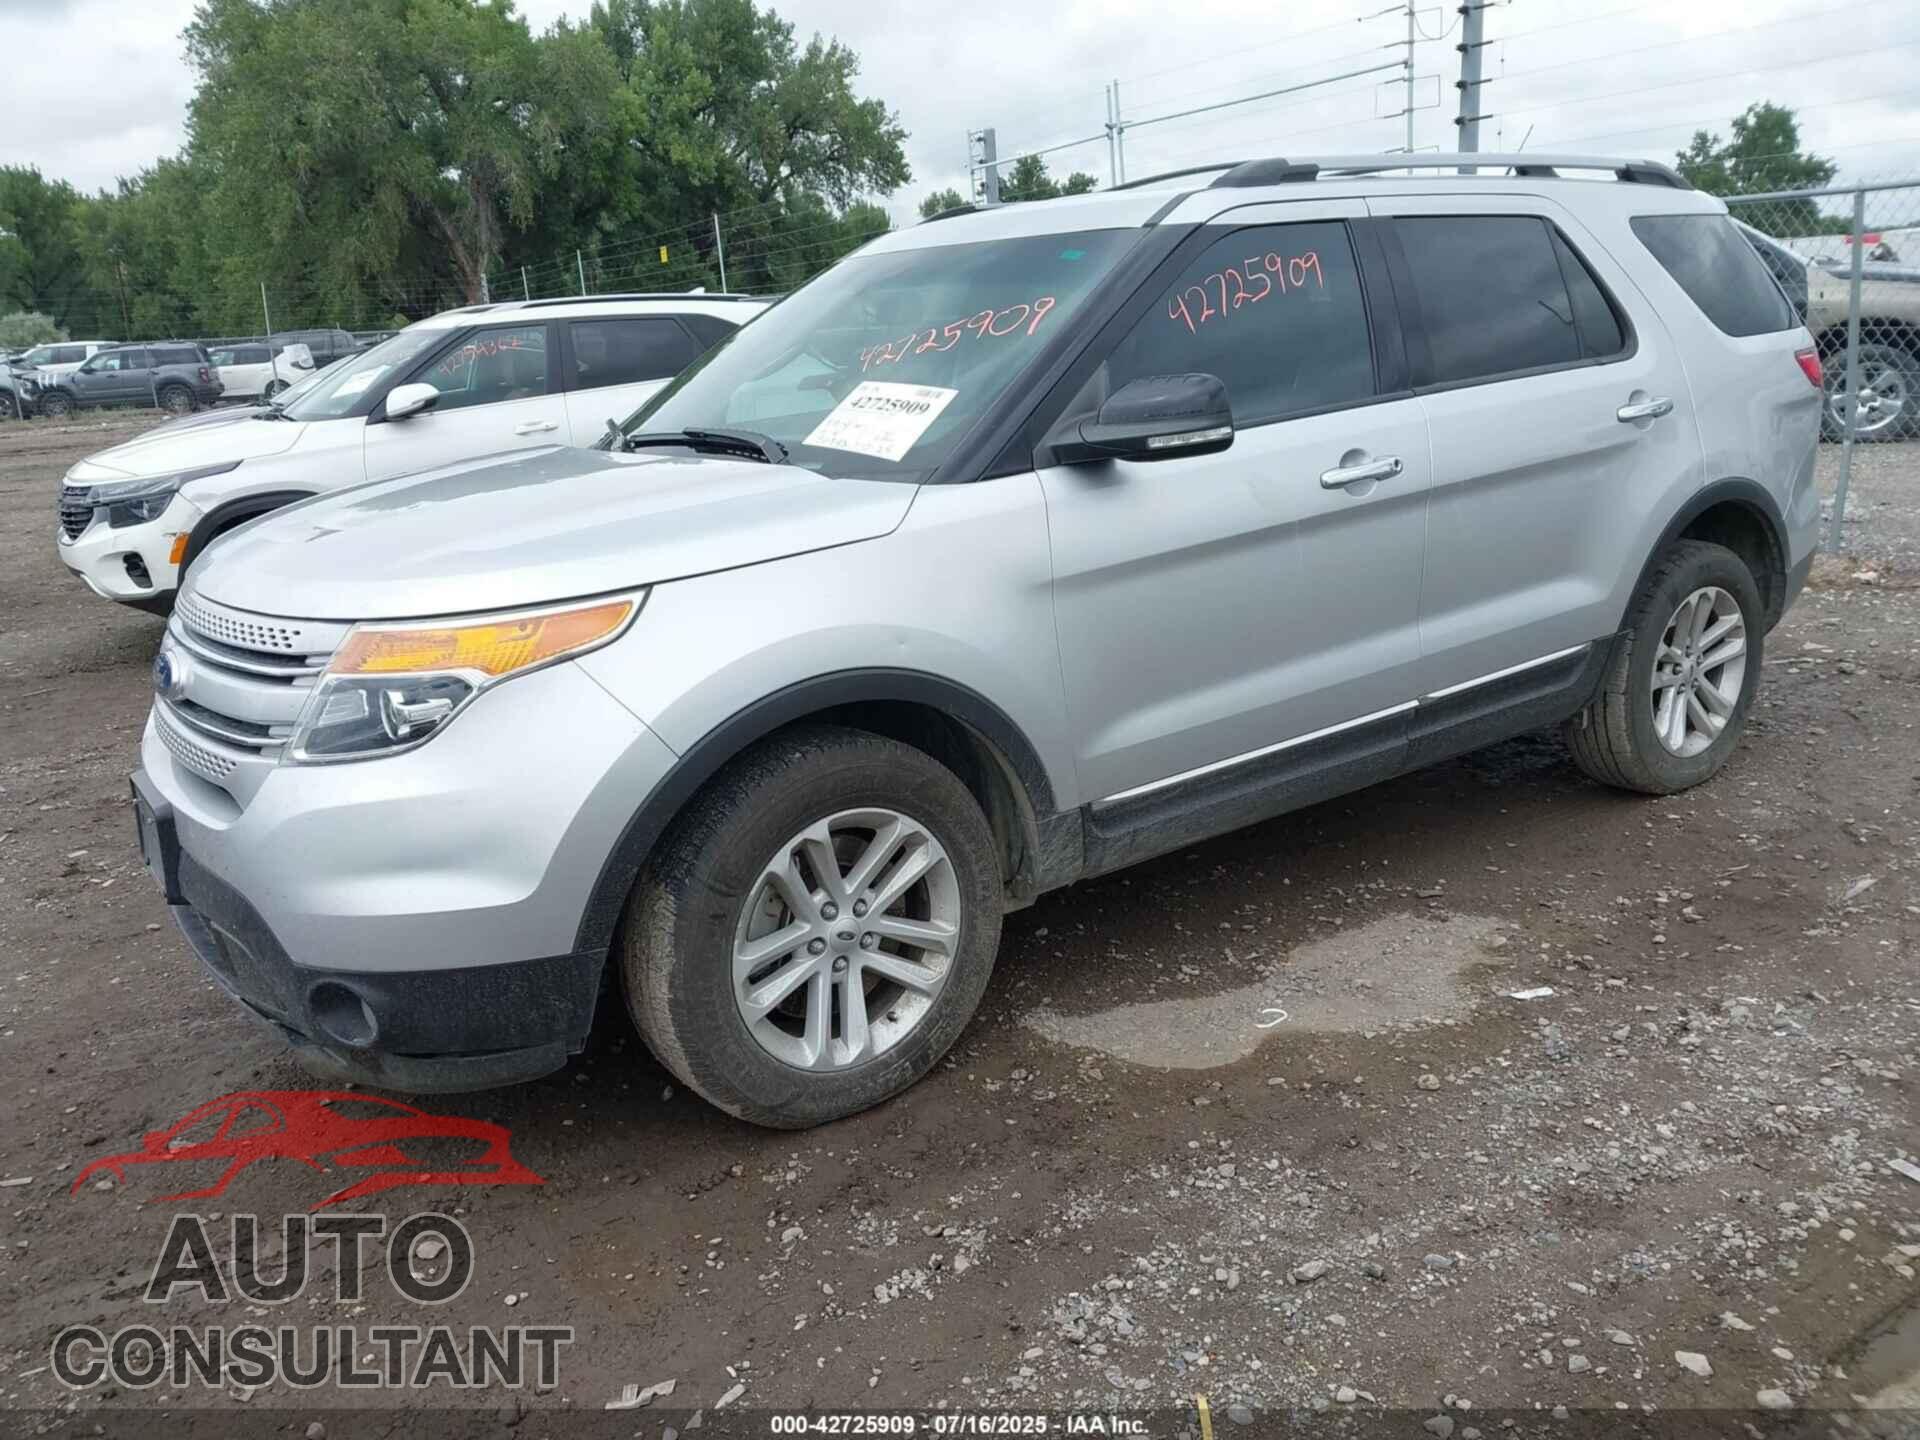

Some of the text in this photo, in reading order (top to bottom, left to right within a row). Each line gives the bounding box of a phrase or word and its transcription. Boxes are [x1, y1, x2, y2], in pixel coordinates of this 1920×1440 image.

[1168, 252, 1324, 335] 42725909
[859, 296, 1056, 373] 42725909
[849, 395, 931, 417] 42725909
